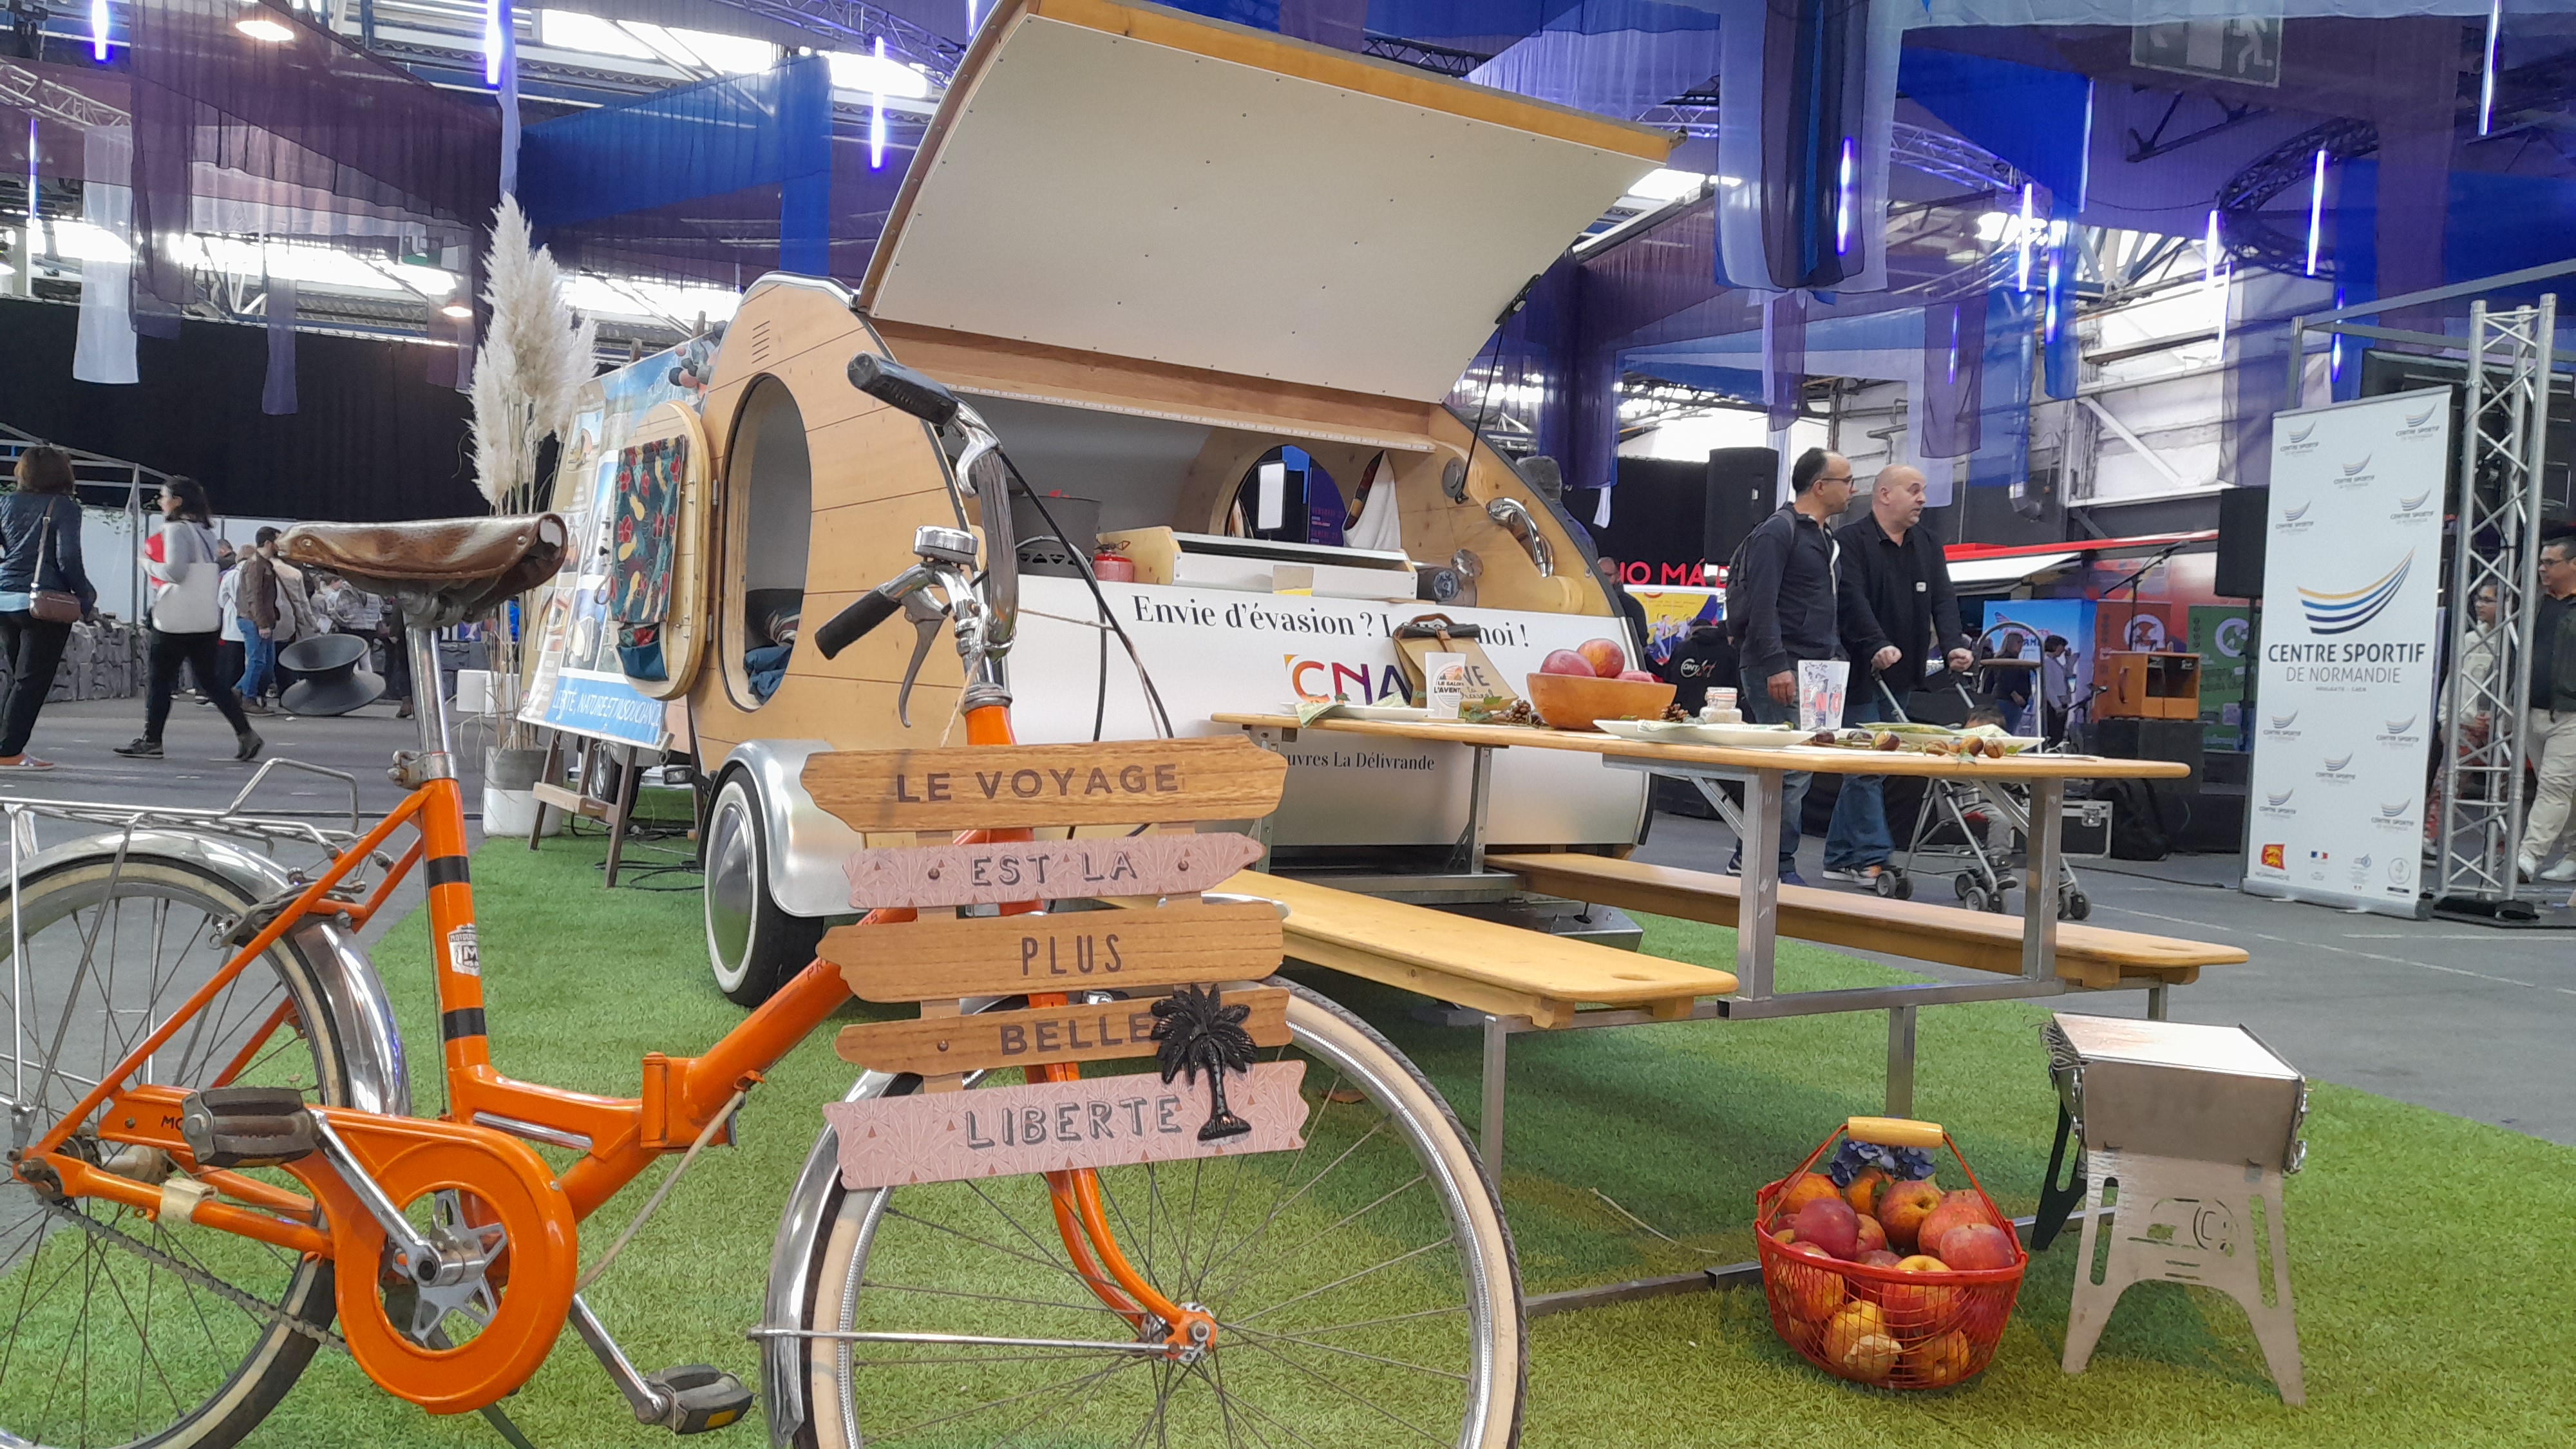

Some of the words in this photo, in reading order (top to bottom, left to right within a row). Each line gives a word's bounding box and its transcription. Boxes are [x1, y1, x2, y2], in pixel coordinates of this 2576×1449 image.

[1132, 595, 1217, 627] Envie
[2268, 644, 2337, 663] CENTRE
[2342, 643, 2426, 663] SPORTIF
[2286, 667, 2305, 682] DE
[2309, 667, 2401, 683] NORMANDIE
[1284, 753, 1329, 767] uvres
[1333, 752, 1351, 767] La
[1356, 752, 1435, 771] Délivrande
[897, 772, 952, 803] LE
[974, 763, 1178, 799] VOYAGE
[971, 853, 1050, 887] EST
[1081, 851, 1138, 882] LA
[1021, 934, 1122, 976] PLUS
[999, 1012, 1152, 1056] BELLE
[966, 1095, 1183, 1150] LIBERTE
